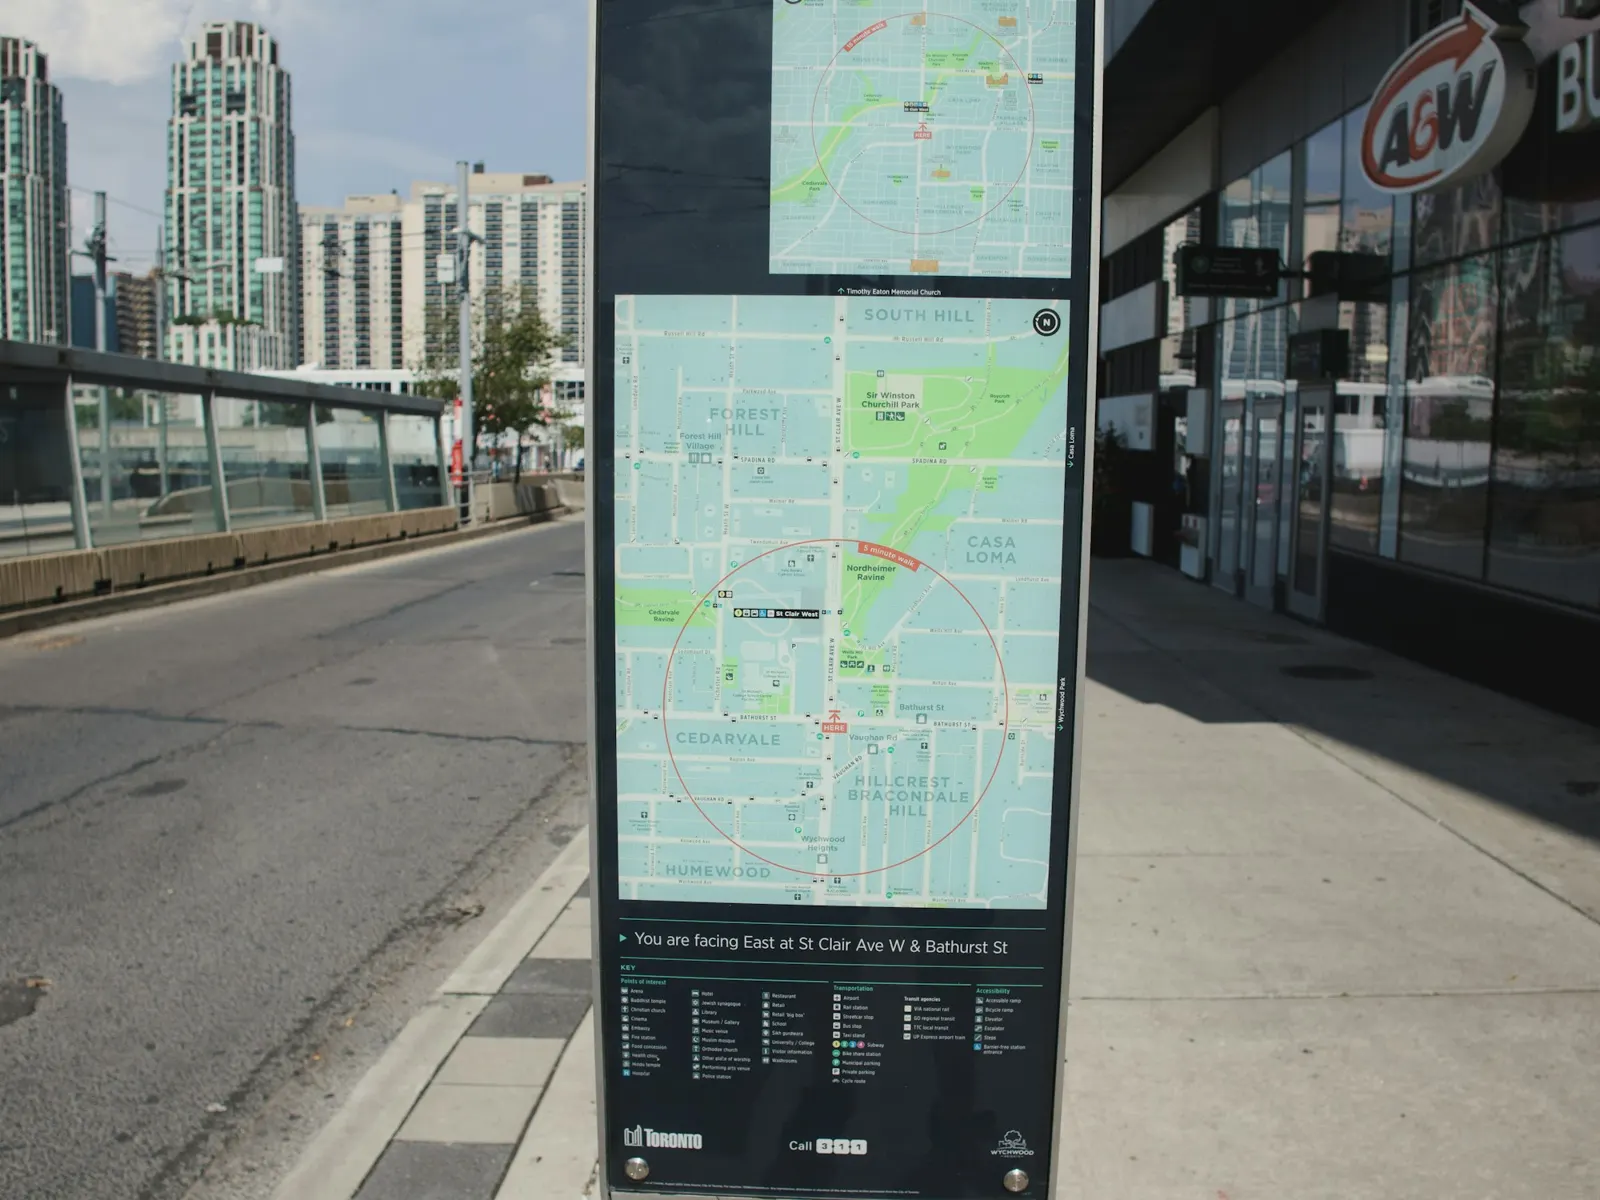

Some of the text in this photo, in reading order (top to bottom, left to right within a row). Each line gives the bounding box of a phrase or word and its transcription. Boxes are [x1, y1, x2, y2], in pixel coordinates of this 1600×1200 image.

[1380, 59, 1497, 174] A&W
[864, 308, 974, 322] SOUTH HILL
[1043, 318, 1050, 326] N
[710, 408, 780, 420] FOREST
[726, 424, 764, 436] HILL
[968, 536, 1016, 548] CASA
[870, 546, 896, 559] minute
[898, 555, 914, 567] walk
[966, 552, 1016, 564] LOMA
[676, 732, 780, 745] CEDARVALE
[832, 761, 855, 780] VAUGHAN
[855, 776, 950, 788] HILLCREST
[848, 790, 968, 802] BRACONDALE
[889, 805, 927, 816] HILL
[666, 865, 771, 878] HUMEWOOD
[635, 932, 1008, 954] You are facing East at St Clair Ave W & Bathurst St
[644, 1128, 702, 1150] TORONTO
[789, 1141, 812, 1150] Call
